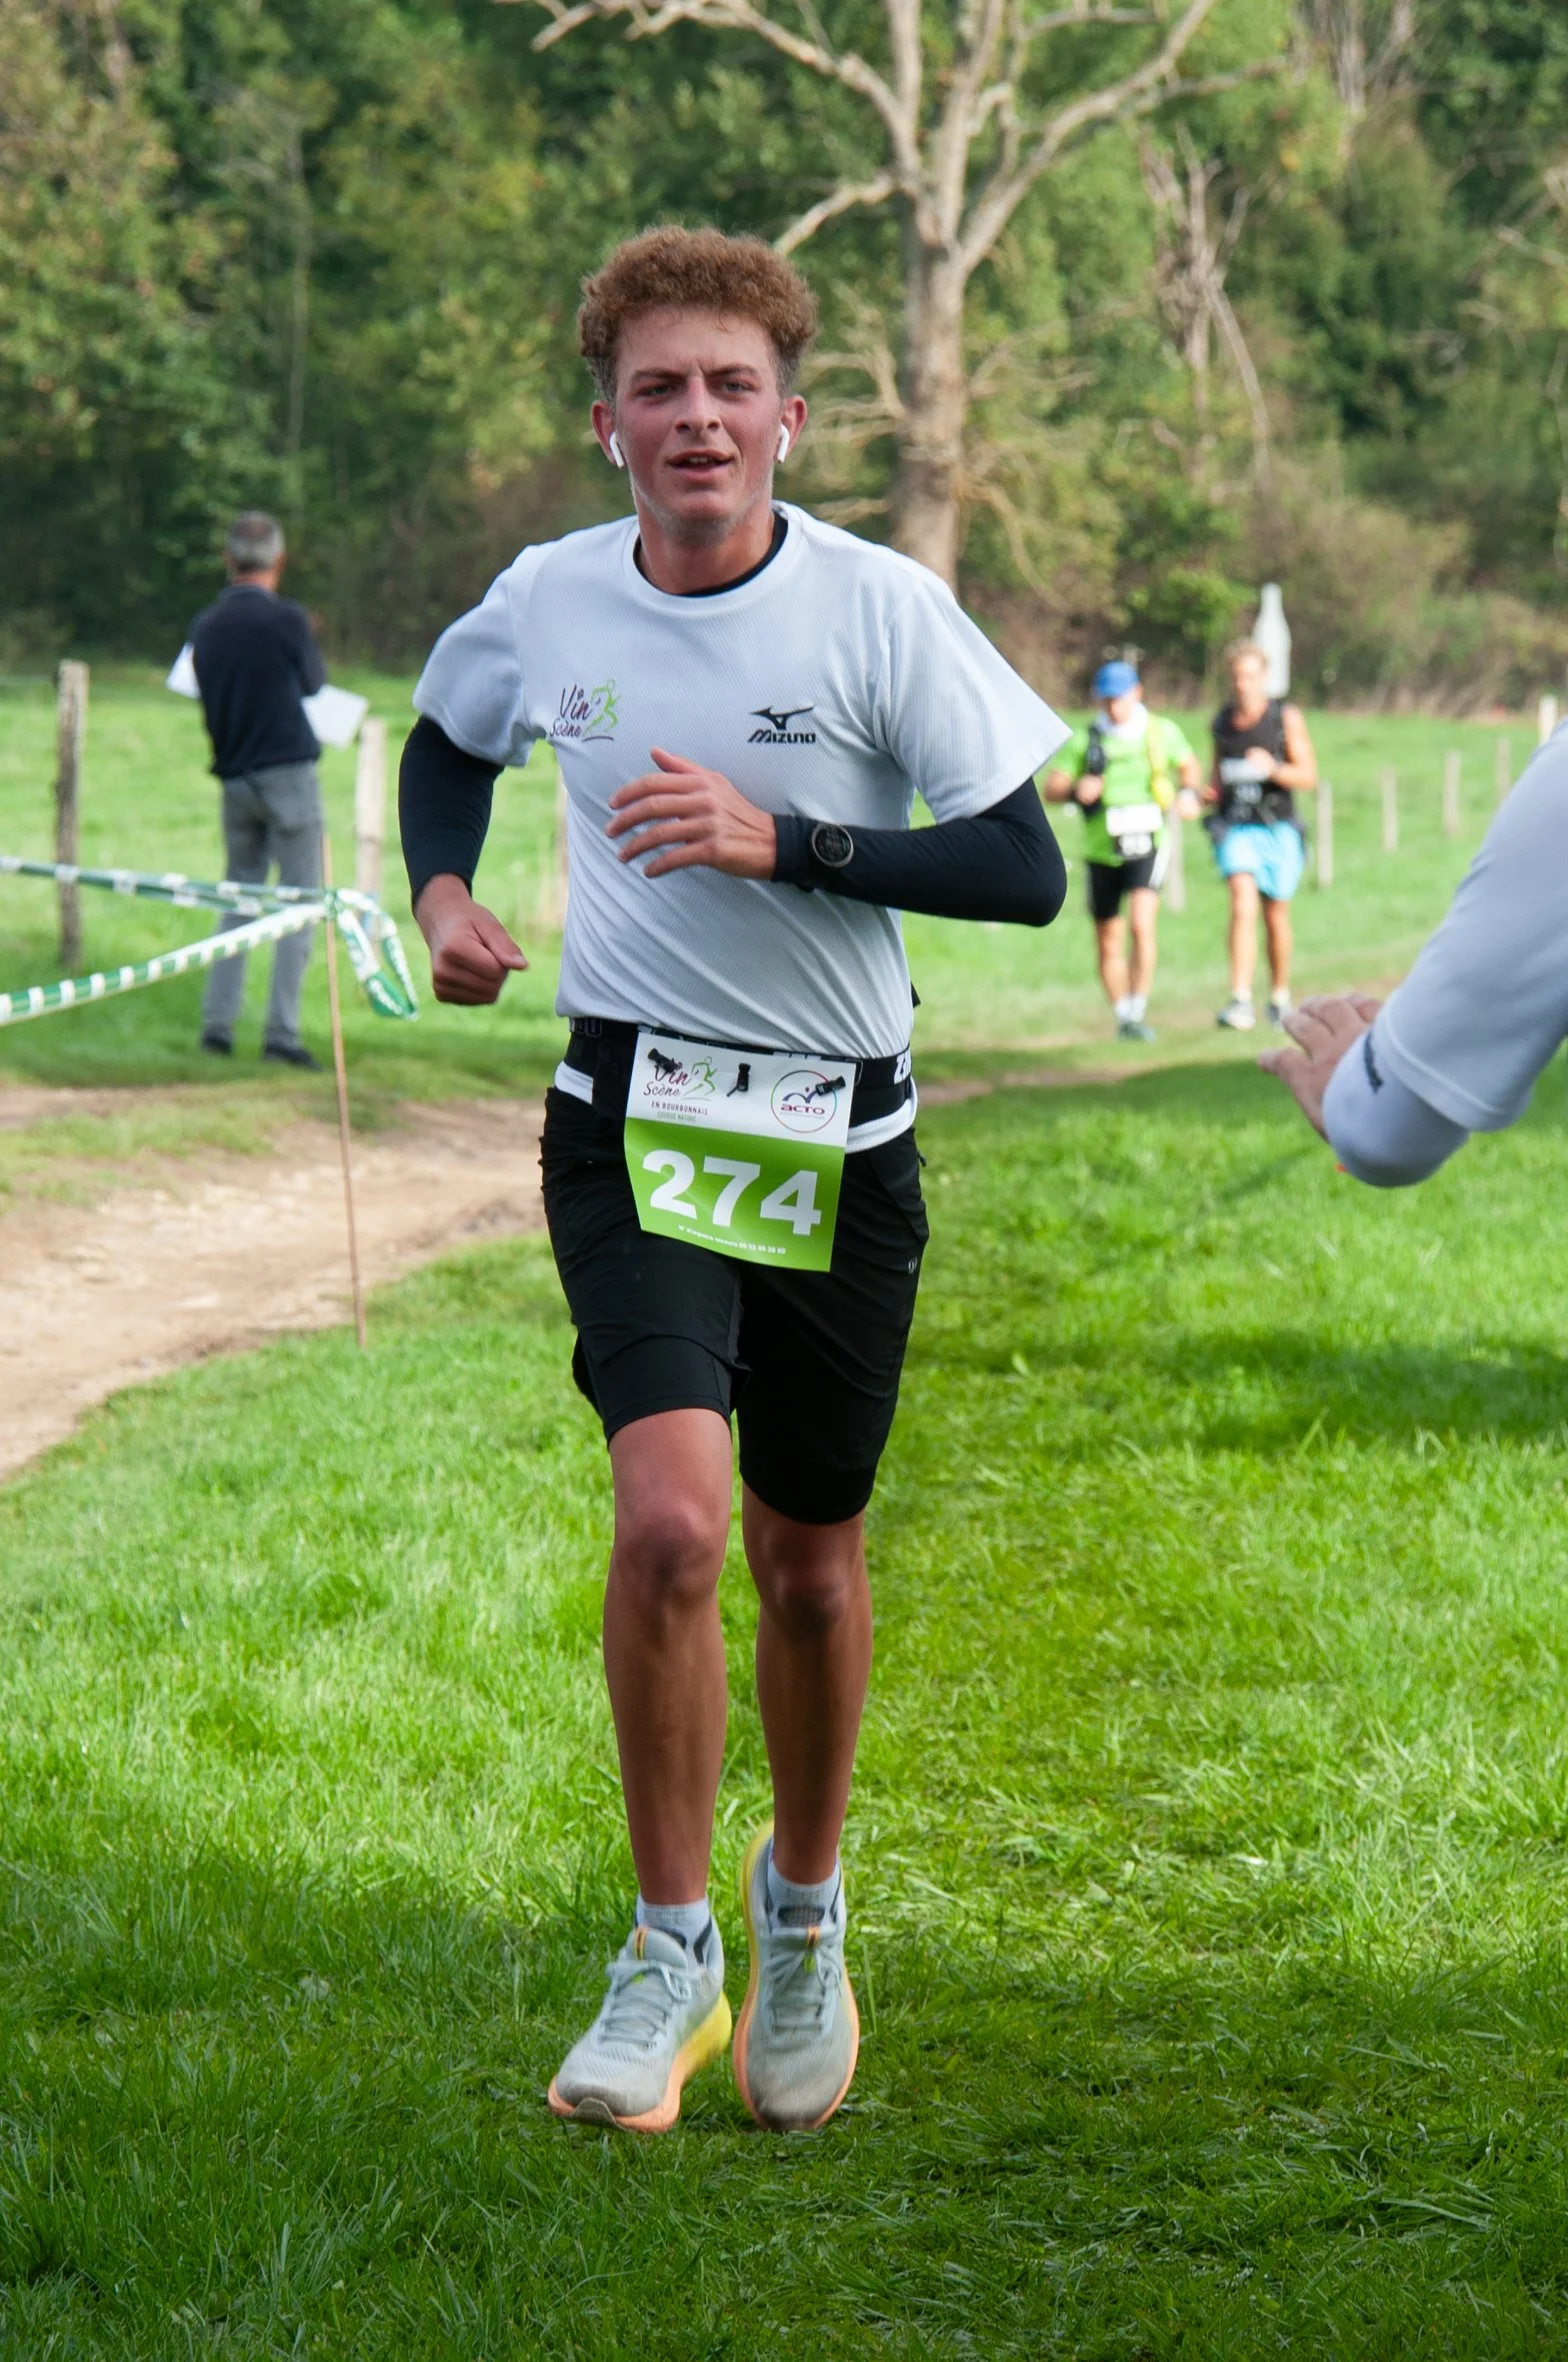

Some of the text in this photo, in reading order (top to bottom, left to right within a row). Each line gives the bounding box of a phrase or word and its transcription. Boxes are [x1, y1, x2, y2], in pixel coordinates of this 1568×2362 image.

[747, 728, 816, 743] MIZUNO
[643, 1081, 680, 1097] Scène
[651, 1101, 708, 1115] EN BOURBONNAIS
[642, 1149, 823, 1236] 274
